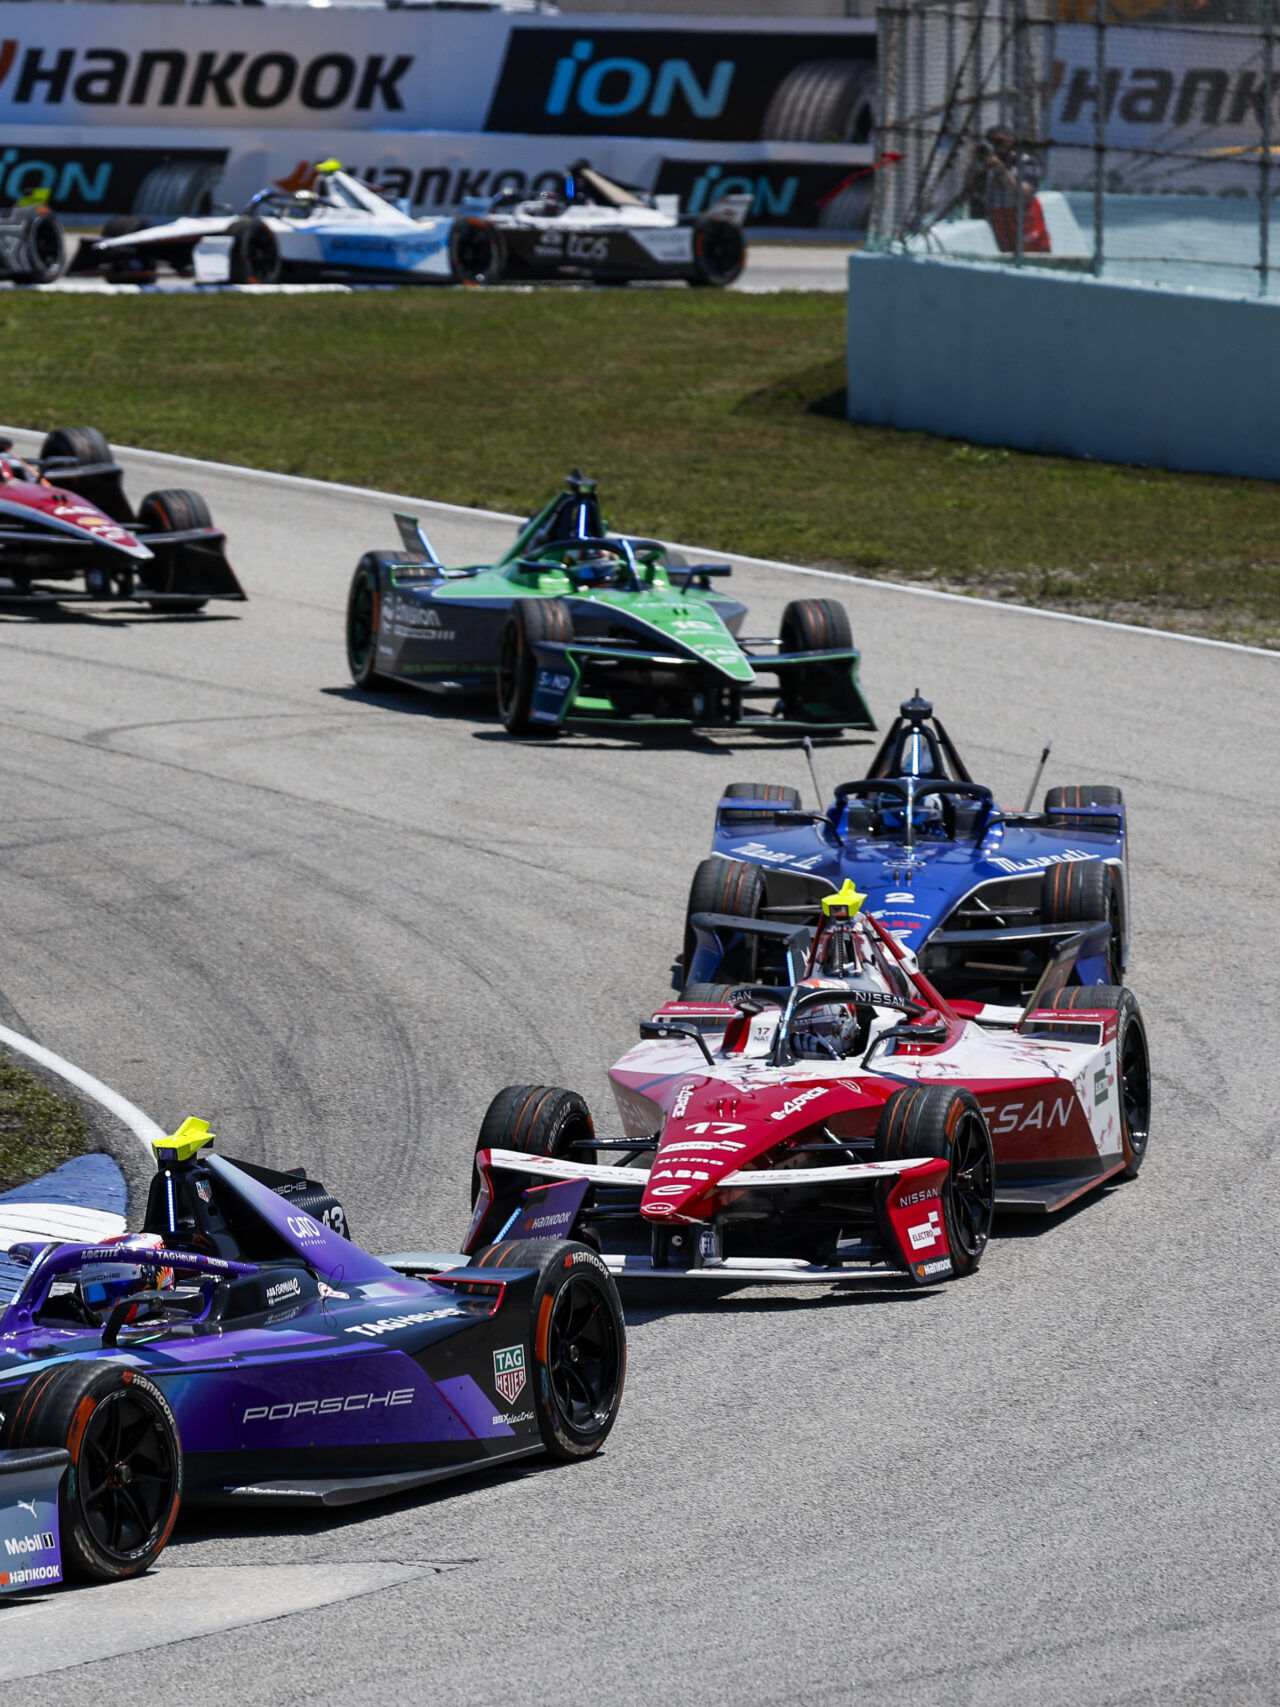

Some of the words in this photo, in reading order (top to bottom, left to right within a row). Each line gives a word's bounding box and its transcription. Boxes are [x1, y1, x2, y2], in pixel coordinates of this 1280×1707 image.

[885, 892, 915, 904] 2
[856, 992, 905, 1007] NISSAN
[685, 1121, 747, 1135] 17
[652, 1169, 710, 1181] ABB
[900, 1187, 939, 1208] NISSAN
[287, 1217, 320, 1239] CATO
[81, 1248, 119, 1260] LOCTITE
[496, 1349, 522, 1370] TAG
[497, 1370, 524, 1400] HEUER
[243, 1388, 415, 1424] PORSCHE
[4, 1533, 43, 1556] Mobil
